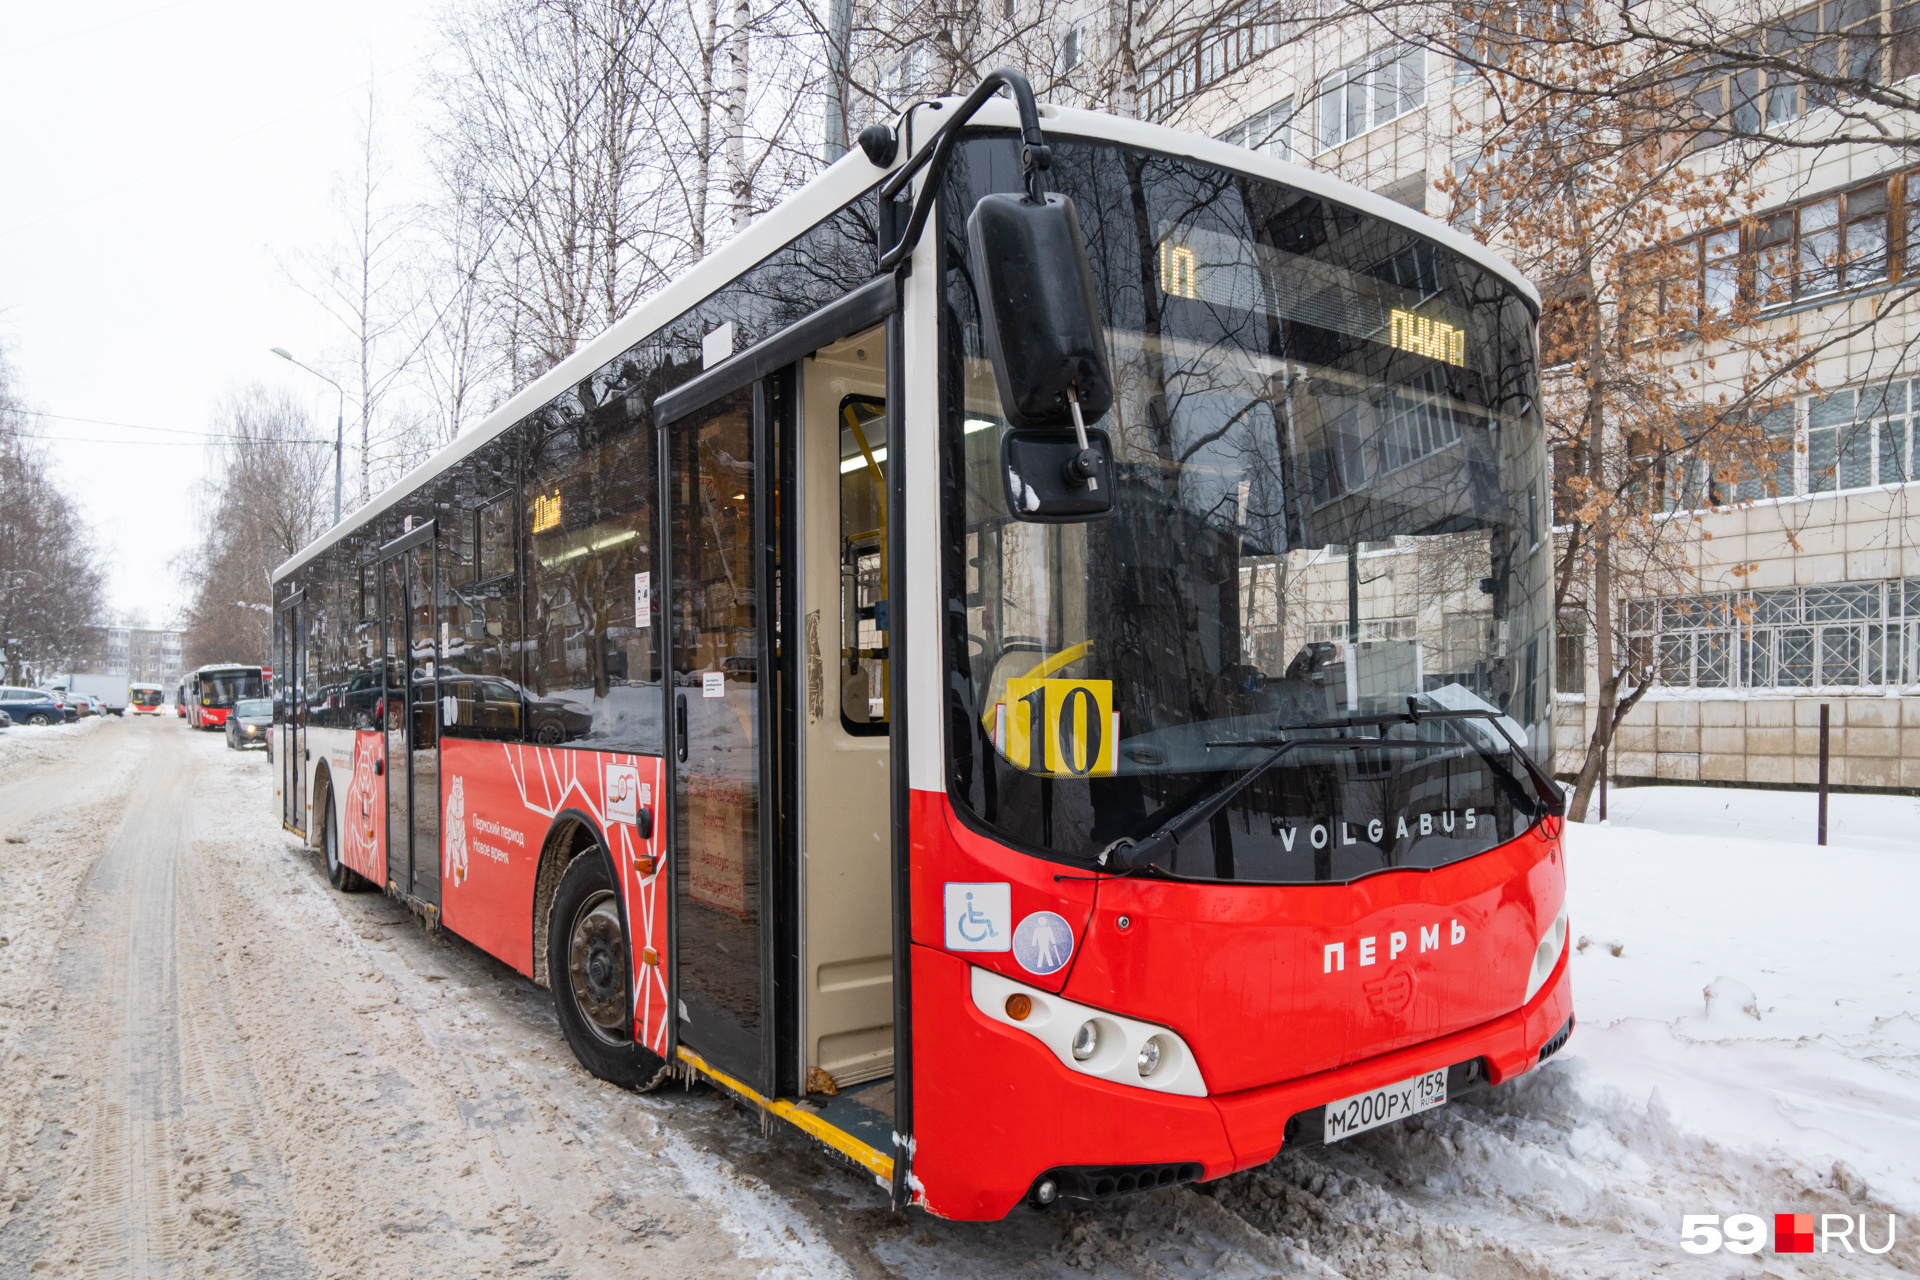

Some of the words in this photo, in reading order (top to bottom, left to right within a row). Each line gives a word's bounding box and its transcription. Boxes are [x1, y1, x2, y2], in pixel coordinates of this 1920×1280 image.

[1017, 685, 1102, 776] 10
[473, 812, 500, 837] Пермский
[501, 826, 525, 848] период
[1279, 807, 1476, 852] VOLGABUS
[473, 836, 490, 857] Новое
[491, 846, 509, 865] время
[1323, 918, 1466, 974] ПЕРМЬ
[1416, 1071, 1443, 1099] 159
[1420, 1096, 1434, 1107] RUS
[1332, 1089, 1412, 1136] М200РХ
